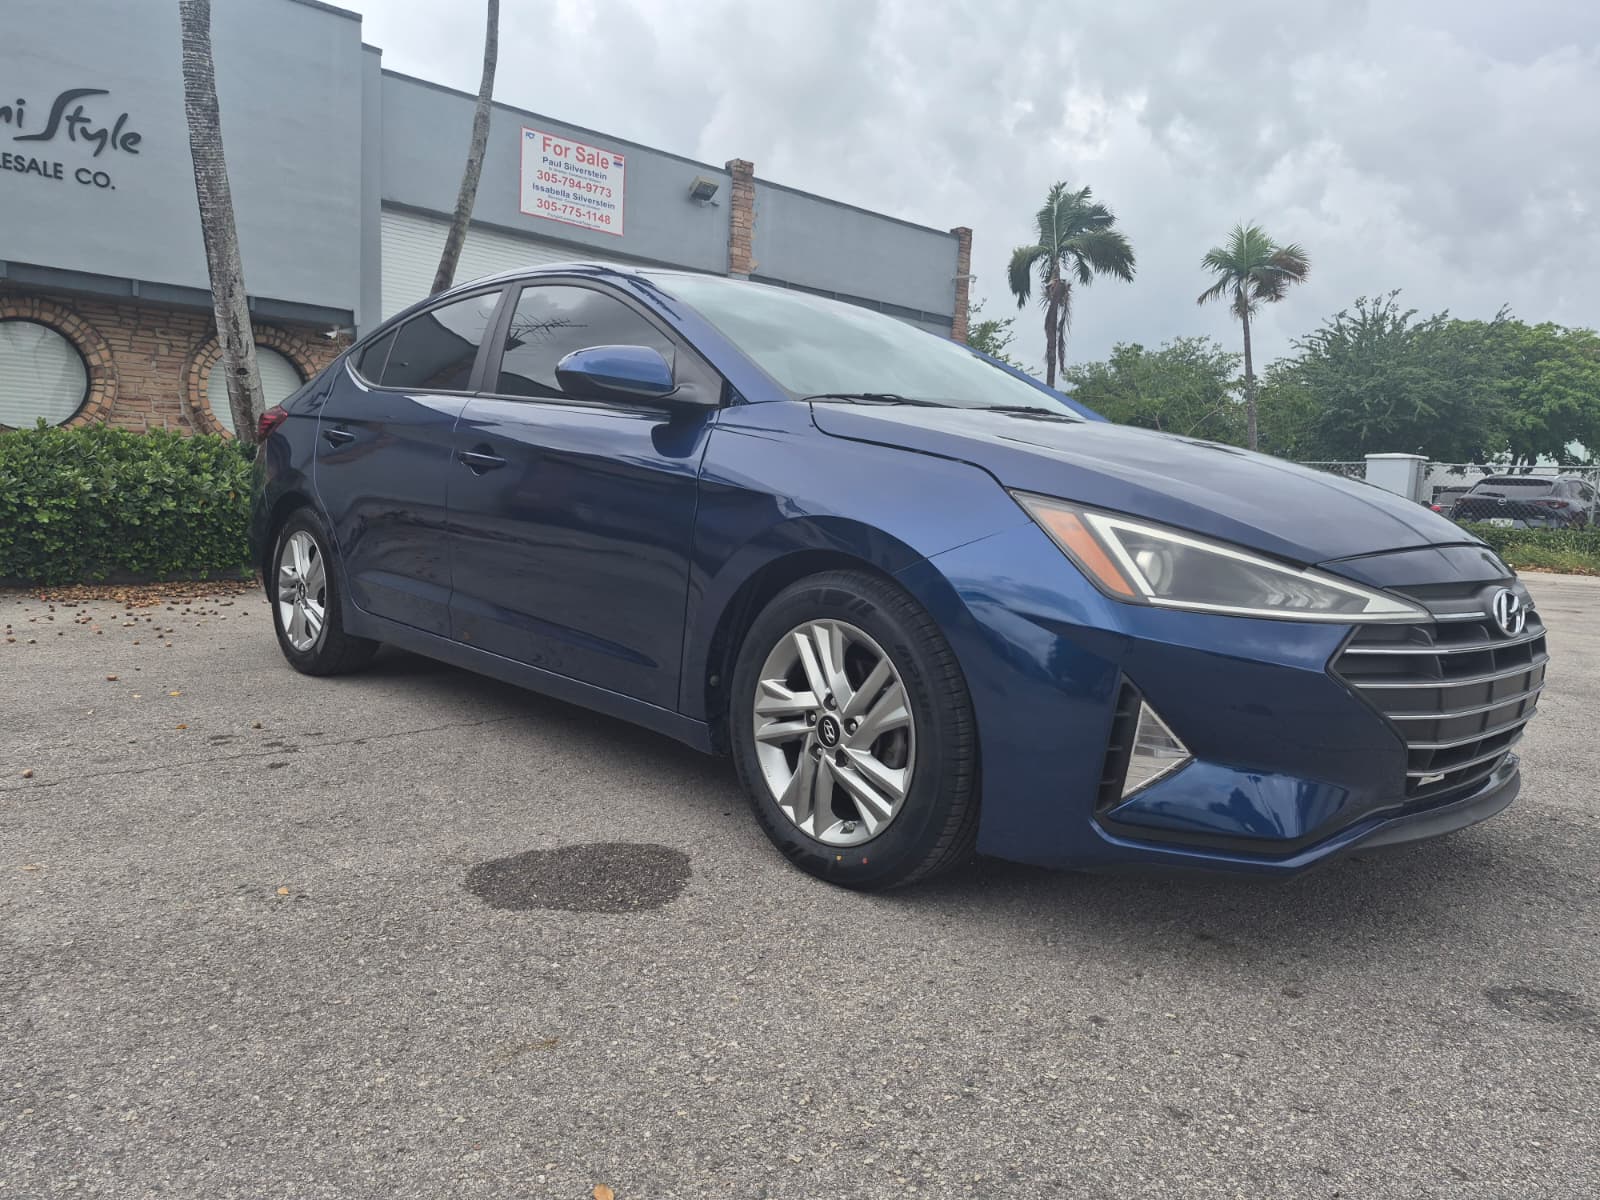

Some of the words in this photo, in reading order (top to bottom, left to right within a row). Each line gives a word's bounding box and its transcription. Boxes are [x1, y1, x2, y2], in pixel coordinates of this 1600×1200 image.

[13, 88, 142, 157] Style
[542, 136, 571, 158] For
[576, 145, 609, 169] Sale
[0, 152, 63, 180] ESALE
[75, 168, 116, 190] CO.
[543, 156, 562, 168] Paul
[564, 162, 607, 181] Silverstein
[532, 182, 570, 198] Issabella
[572, 193, 615, 210] Silverstein
[537, 169, 612, 198] 305-794-9773
[537, 198, 611, 225] 305-775-1148
